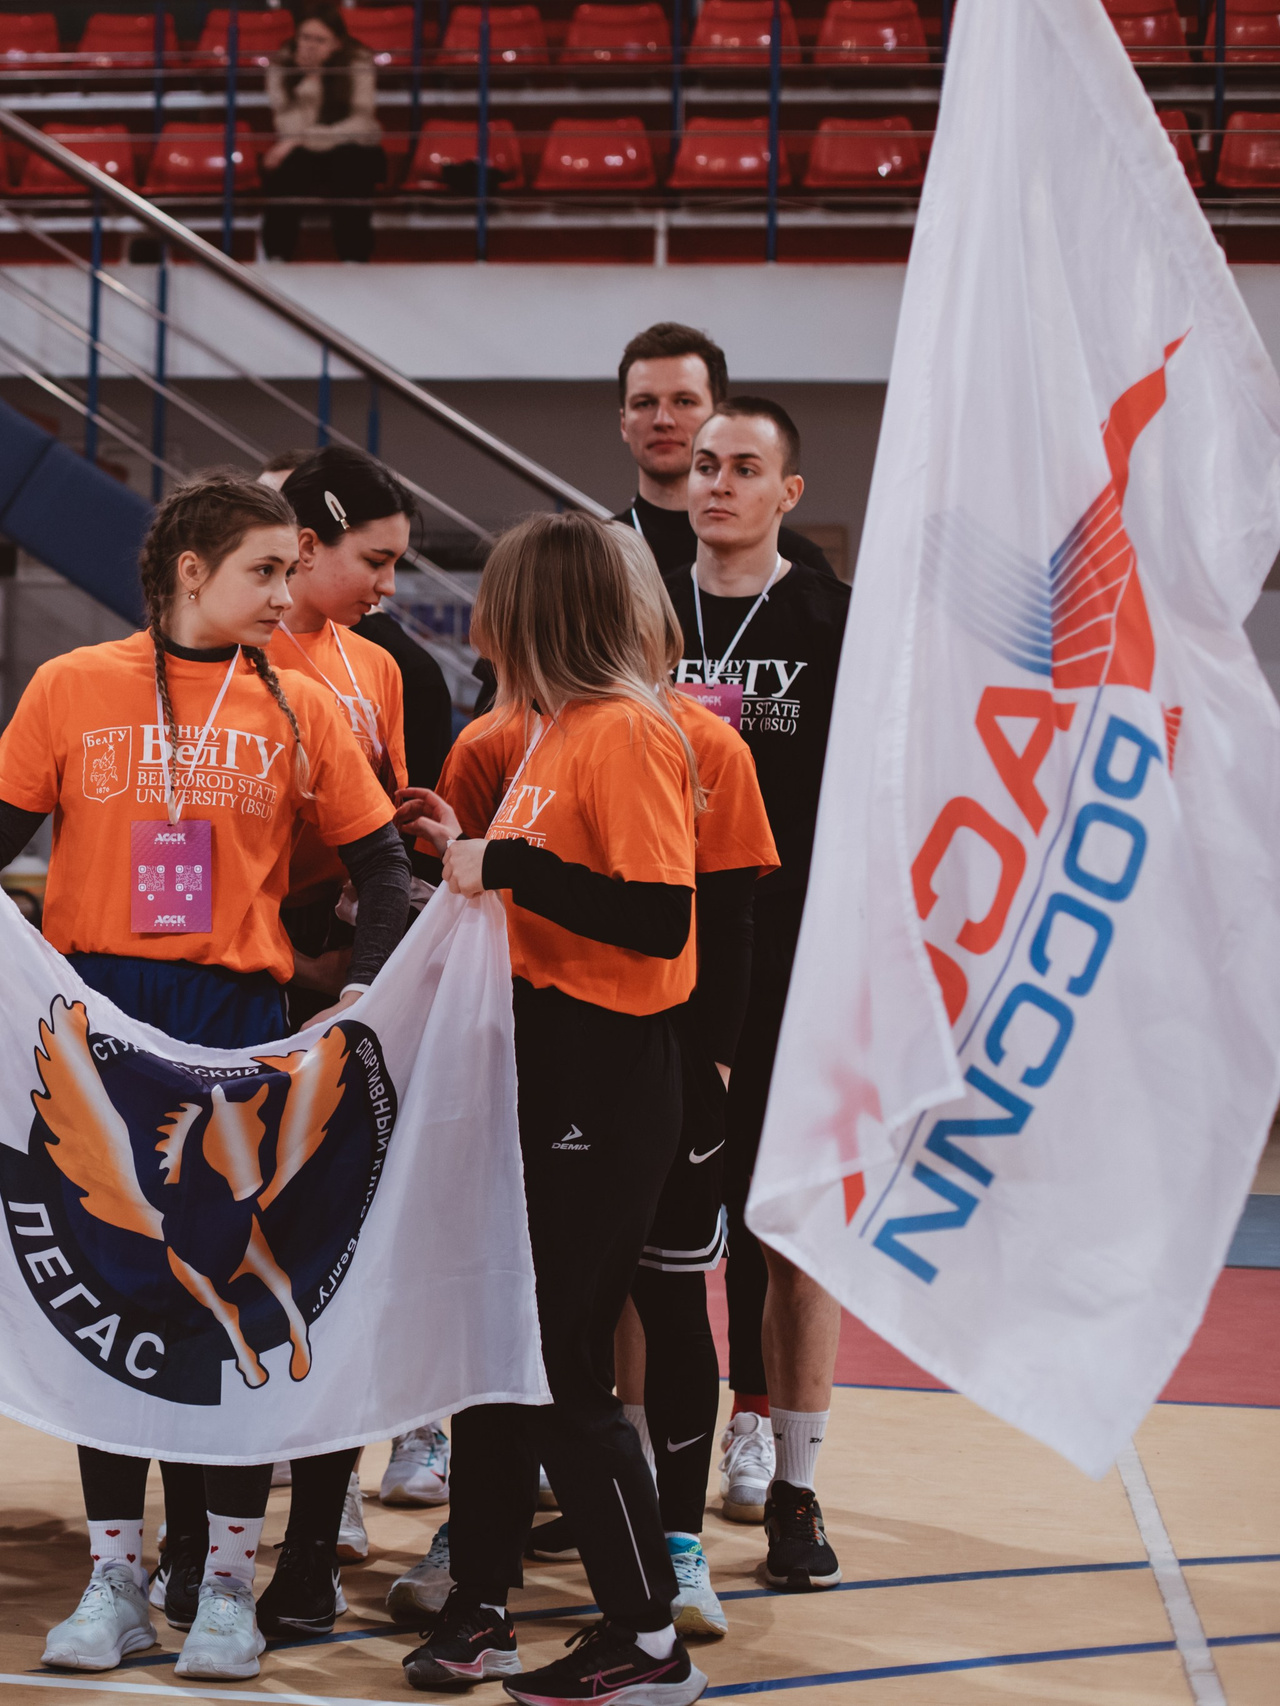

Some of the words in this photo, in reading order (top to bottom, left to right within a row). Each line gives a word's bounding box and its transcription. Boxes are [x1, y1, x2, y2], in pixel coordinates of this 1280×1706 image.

[755, 702, 801, 718] STATE
[177, 725, 223, 742] НИУ
[759, 717, 798, 736] (BSU)
[86, 730, 128, 748] БелГУ
[139, 724, 286, 779] БелГУ
[137, 770, 234, 789] BELGOROD
[237, 778, 279, 806] STATE
[239, 796, 274, 823] (BSU)
[551, 1142, 592, 1151] DEMIX
[8, 1200, 166, 1380] ПЕГАС
